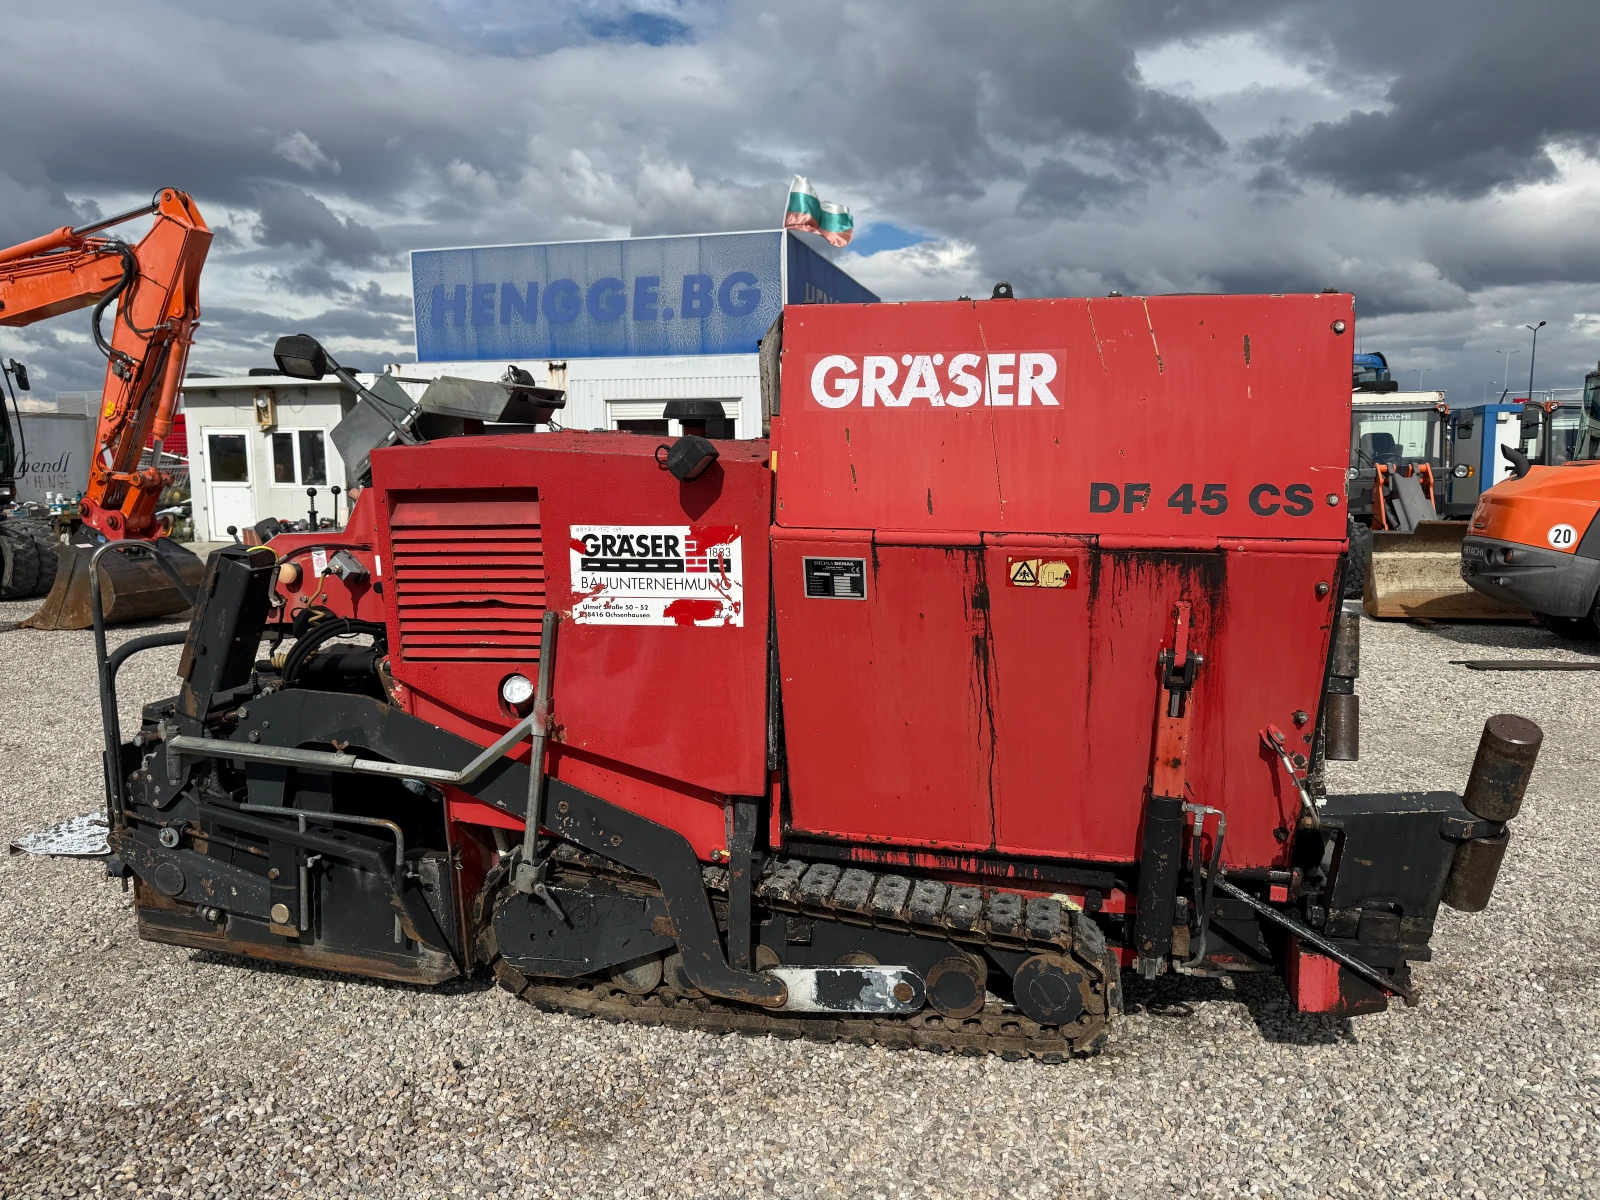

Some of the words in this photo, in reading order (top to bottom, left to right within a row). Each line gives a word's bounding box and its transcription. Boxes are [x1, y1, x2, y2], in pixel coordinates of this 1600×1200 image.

[430, 271, 761, 326] HENGGE.BG
[810, 353, 1060, 408] GRÄSER
[1089, 482, 1151, 514] DF
[1167, 483, 1229, 516] 45
[1248, 483, 1315, 517] CS
[581, 533, 681, 558] GRÄSER
[1553, 528, 1571, 543] 20
[1463, 545, 1484, 557] HITACHI
